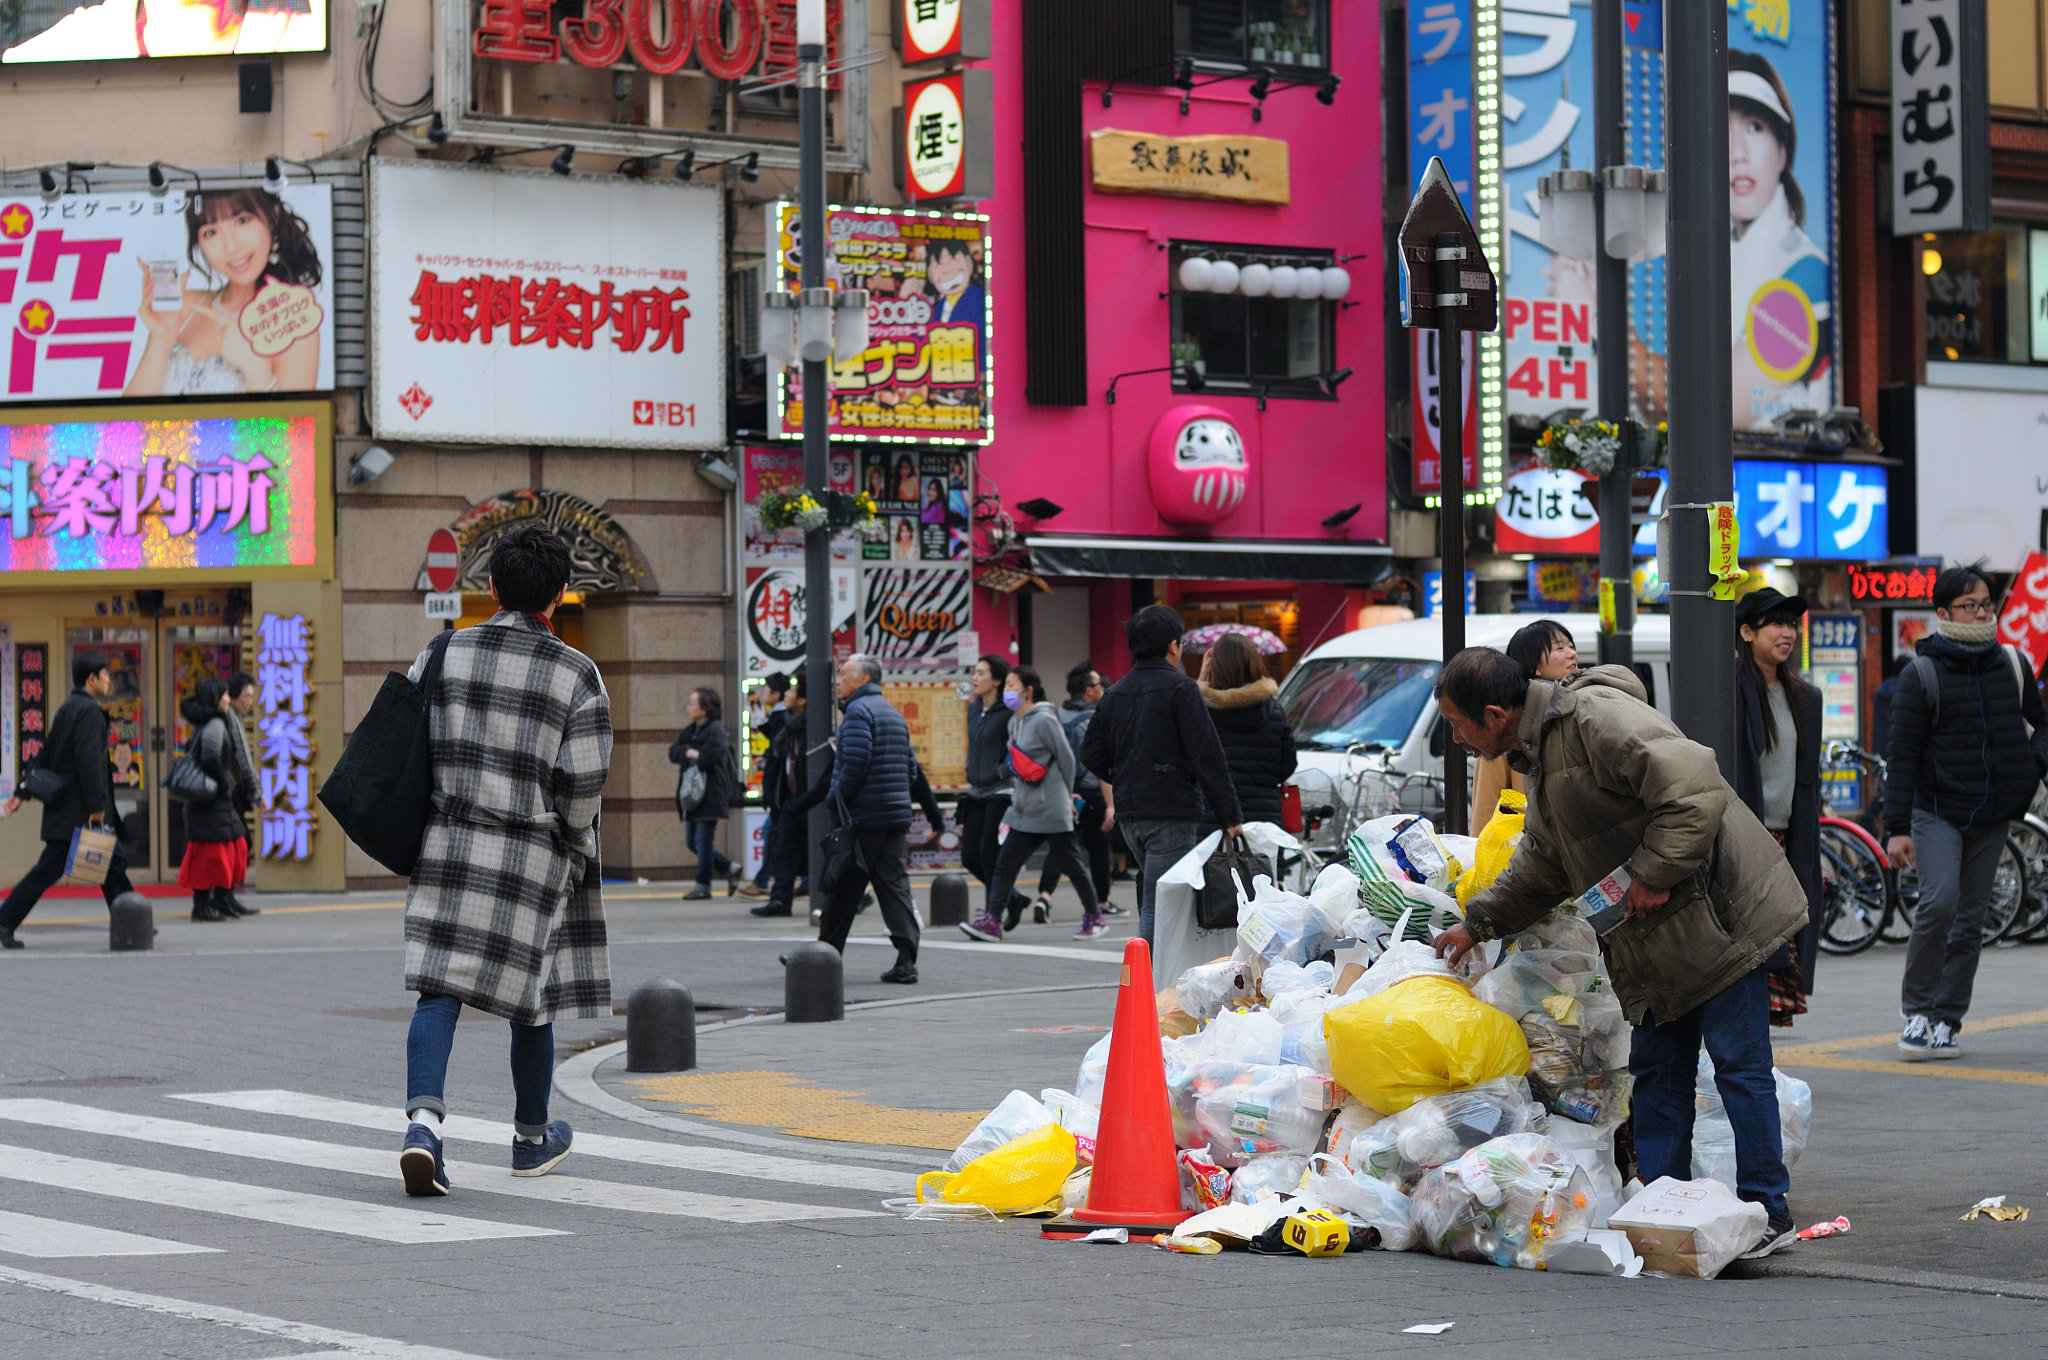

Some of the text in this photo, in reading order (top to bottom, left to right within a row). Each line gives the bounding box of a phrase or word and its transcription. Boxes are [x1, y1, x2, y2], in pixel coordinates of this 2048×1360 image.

[1901, 0, 1955, 214] いむら
[411, 270, 690, 353] 無料案内所
[668, 402, 695, 427] B1
[833, 462, 849, 477] 5F
[1507, 485, 1594, 521] たばこ
[880, 604, 955, 639] Queen
[1812, 621, 1857, 646] カラオケ
[749, 656, 767, 671] 2F
[21, 650, 44, 777] 無料案内
[257, 613, 313, 859] 無料案内所
